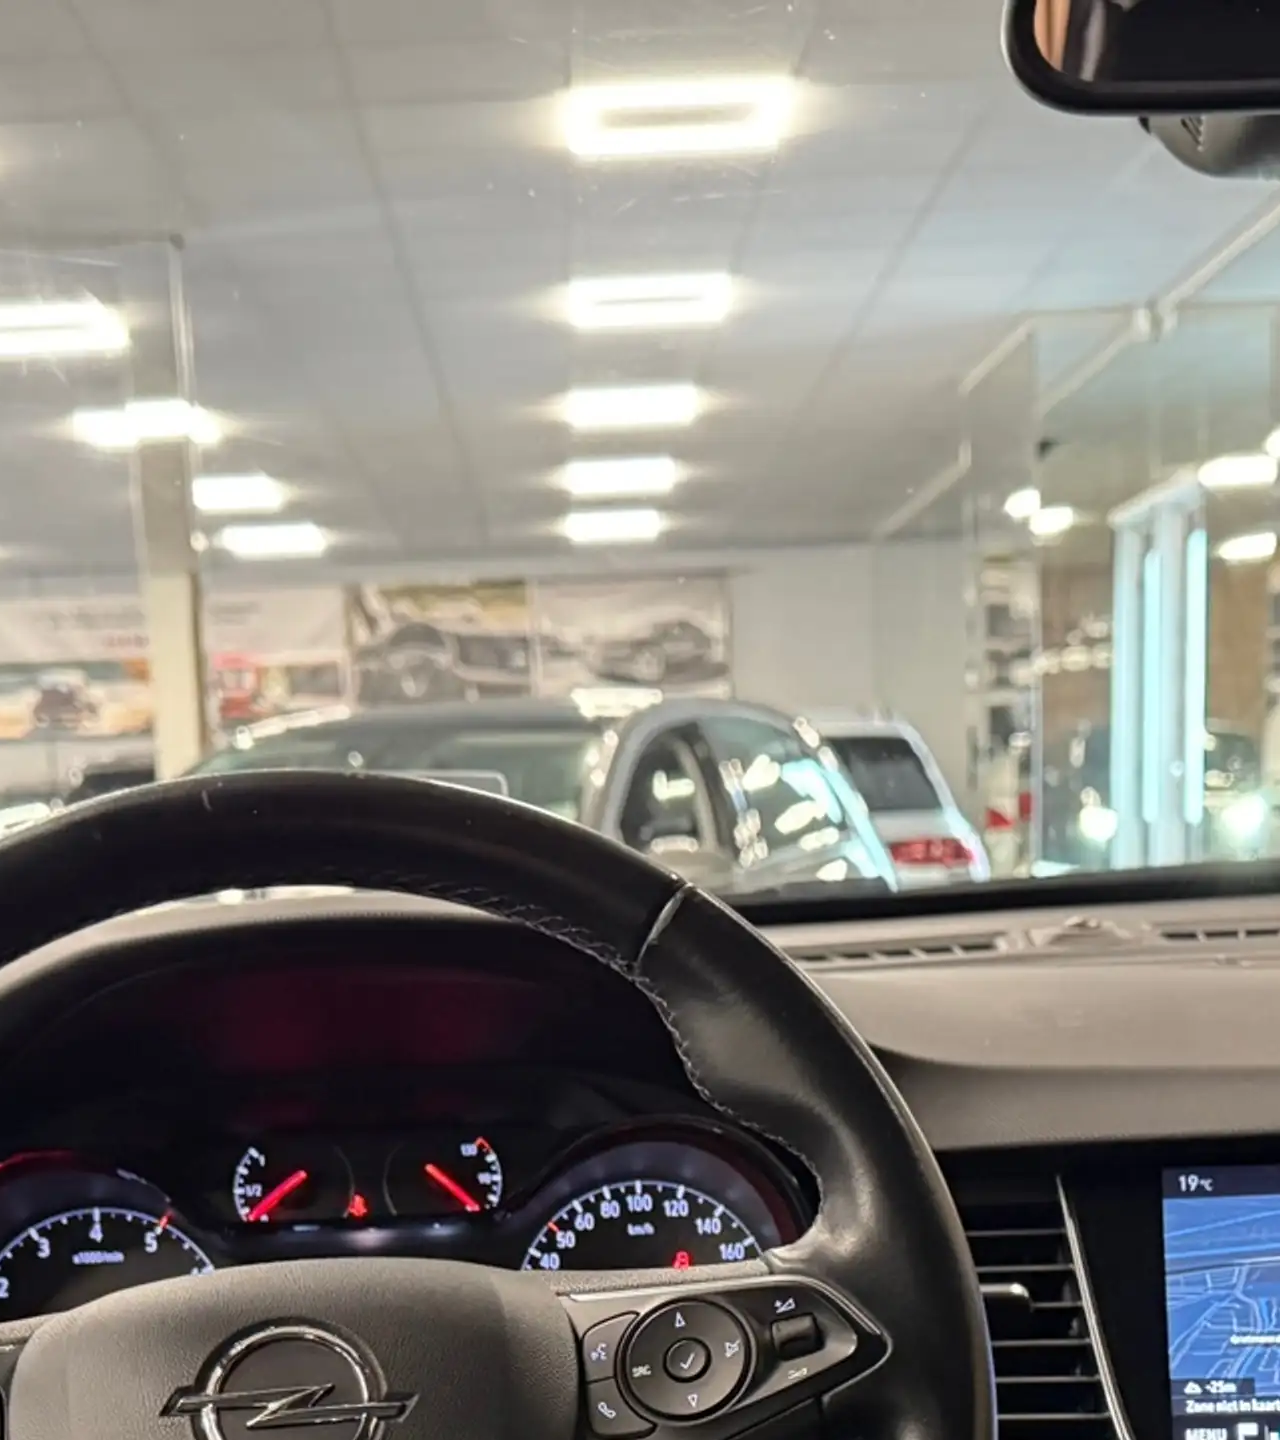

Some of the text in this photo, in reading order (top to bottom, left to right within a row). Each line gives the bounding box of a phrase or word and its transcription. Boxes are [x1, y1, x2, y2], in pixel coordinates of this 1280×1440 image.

[600, 1200, 620, 1218] 80
[626, 1194, 653, 1212] 100
[663, 1199, 689, 1218] 120
[574, 1212, 595, 1230] 60
[695, 1217, 721, 1235] 140
[89, 1223, 103, 1243] 4
[144, 1231, 158, 1253] 5
[556, 1231, 576, 1249] 50
[36, 1237, 51, 1258] 3
[719, 1243, 745, 1261] 160
[539, 1253, 560, 1270] 40
